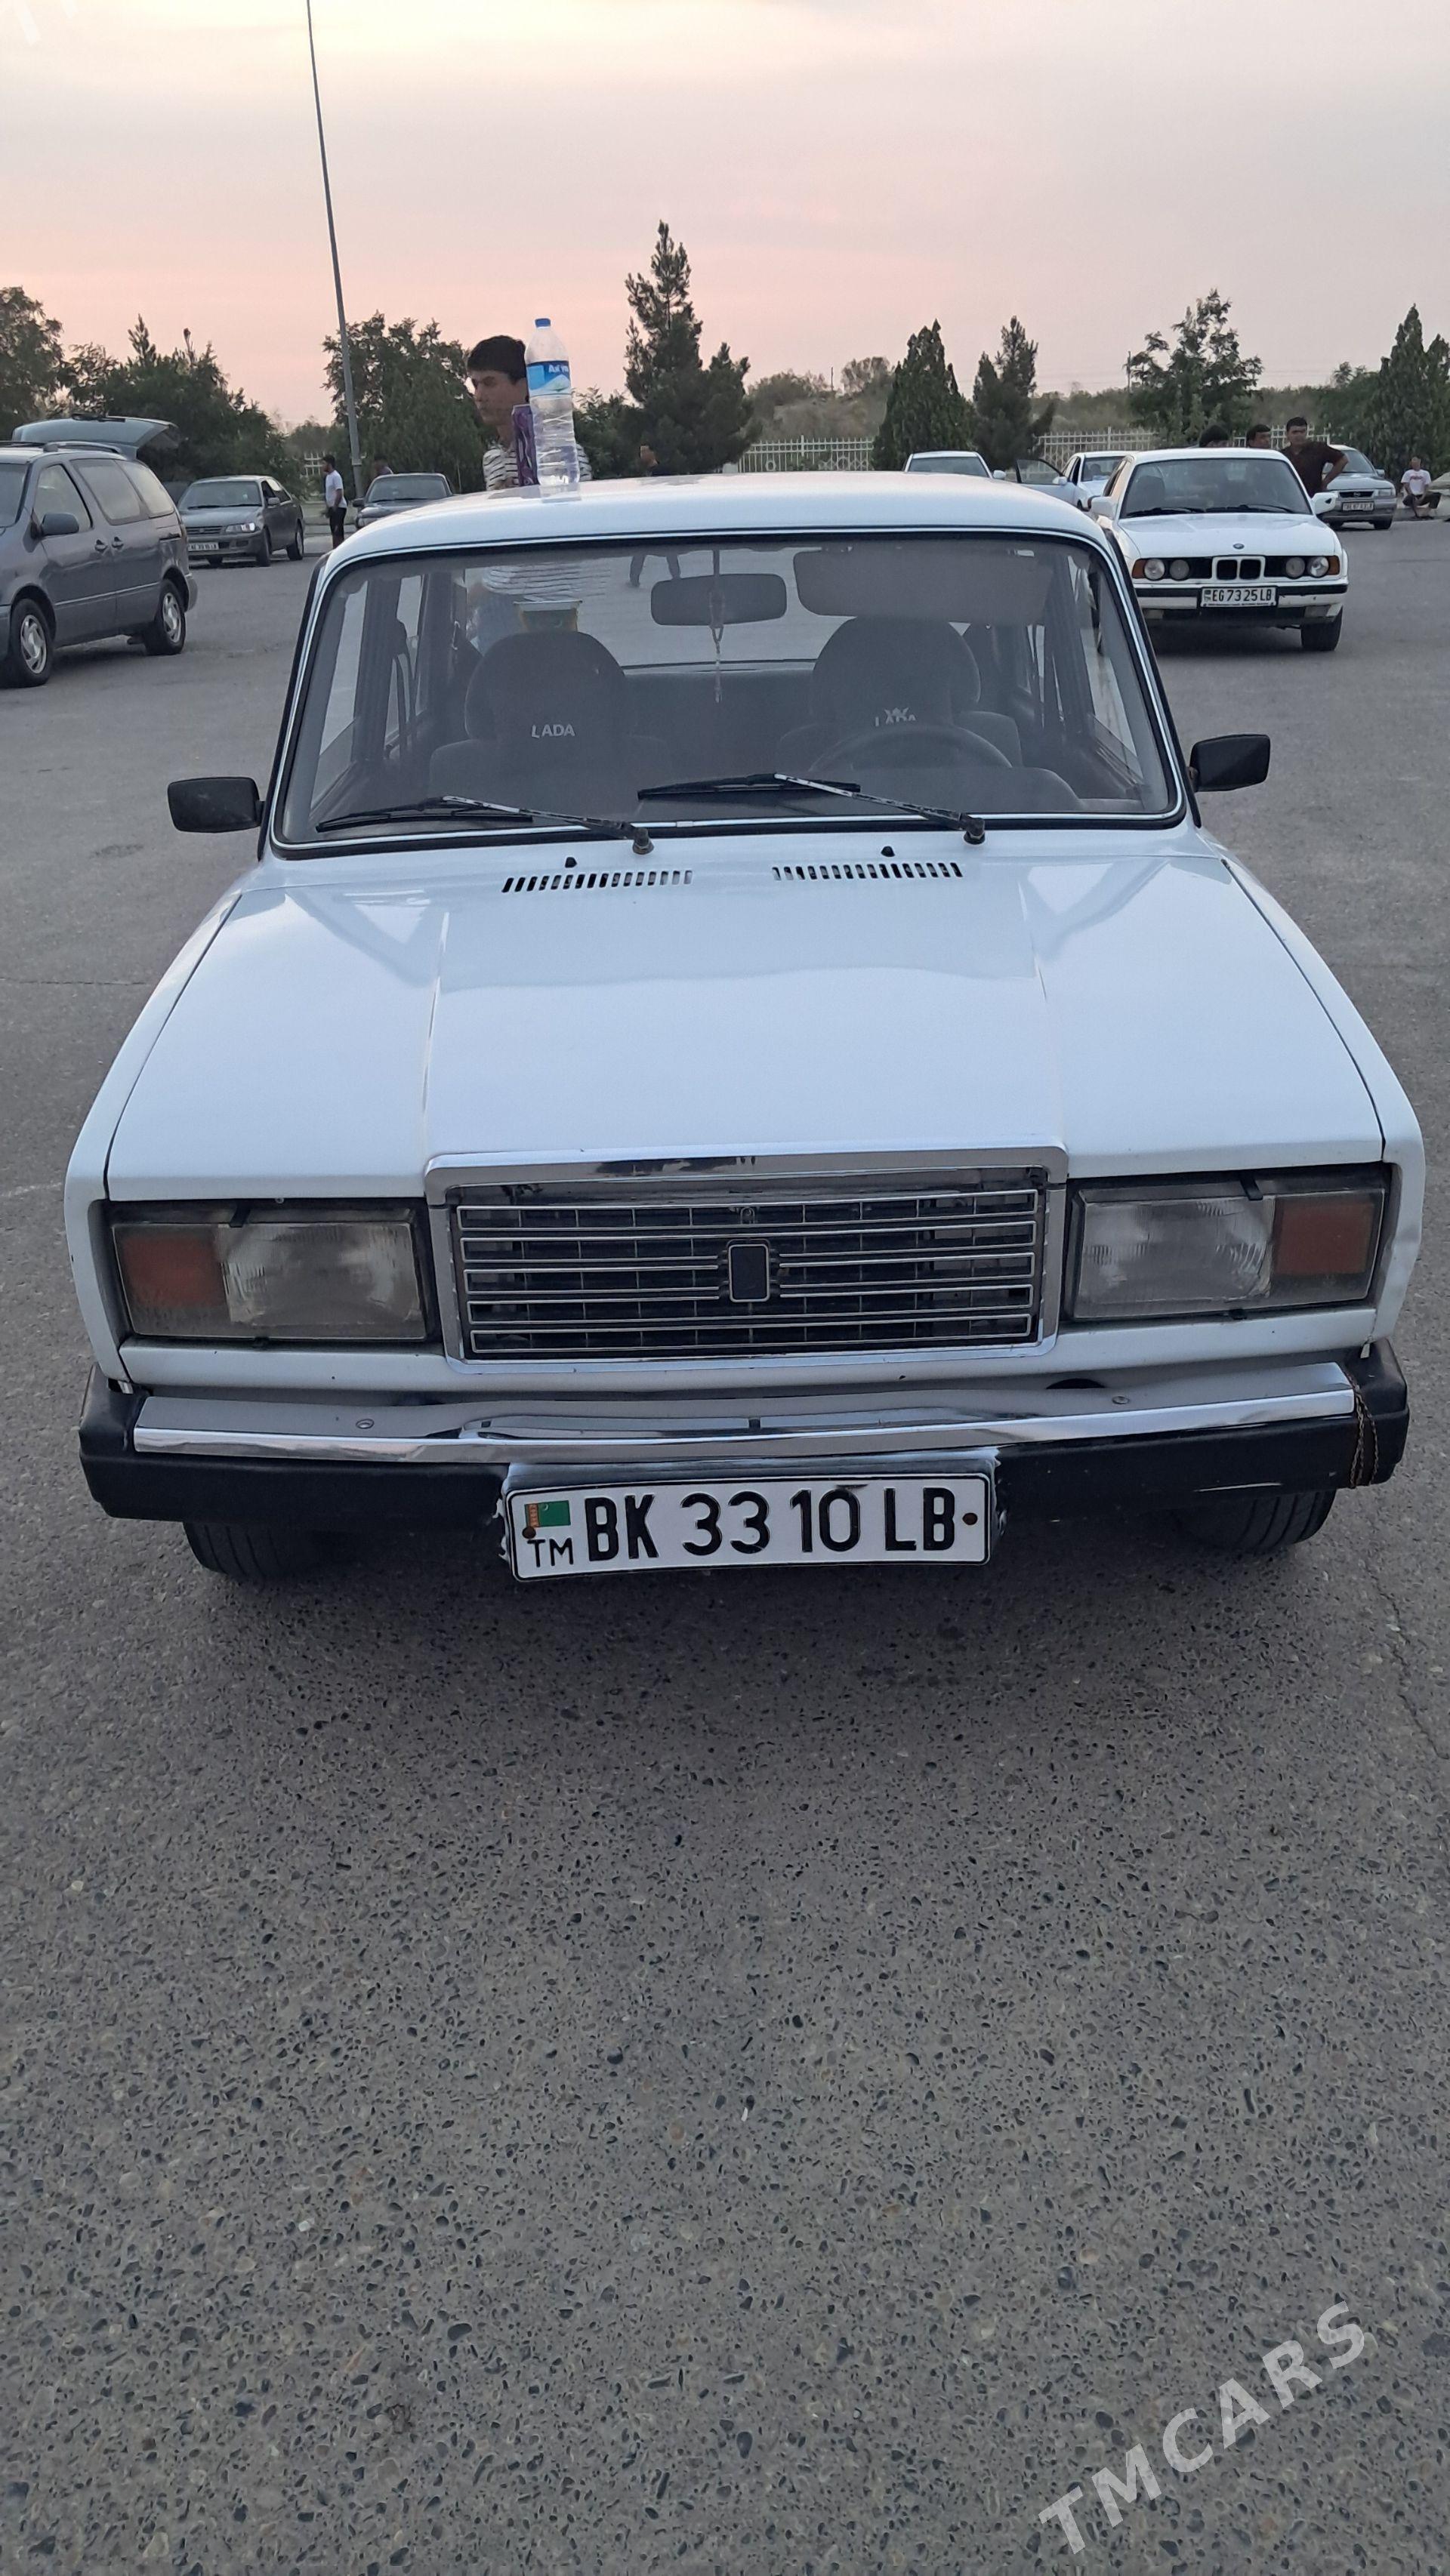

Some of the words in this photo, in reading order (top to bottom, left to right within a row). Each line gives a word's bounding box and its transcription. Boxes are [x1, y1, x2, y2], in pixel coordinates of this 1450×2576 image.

[1212, 589, 1224, 601] EG
[1260, 589, 1273, 601] LB
[532, 724, 575, 738] LADA
[584, 1494, 659, 1561] BK
[884, 1487, 955, 1551] LB
[527, 1538, 574, 1567] TM
